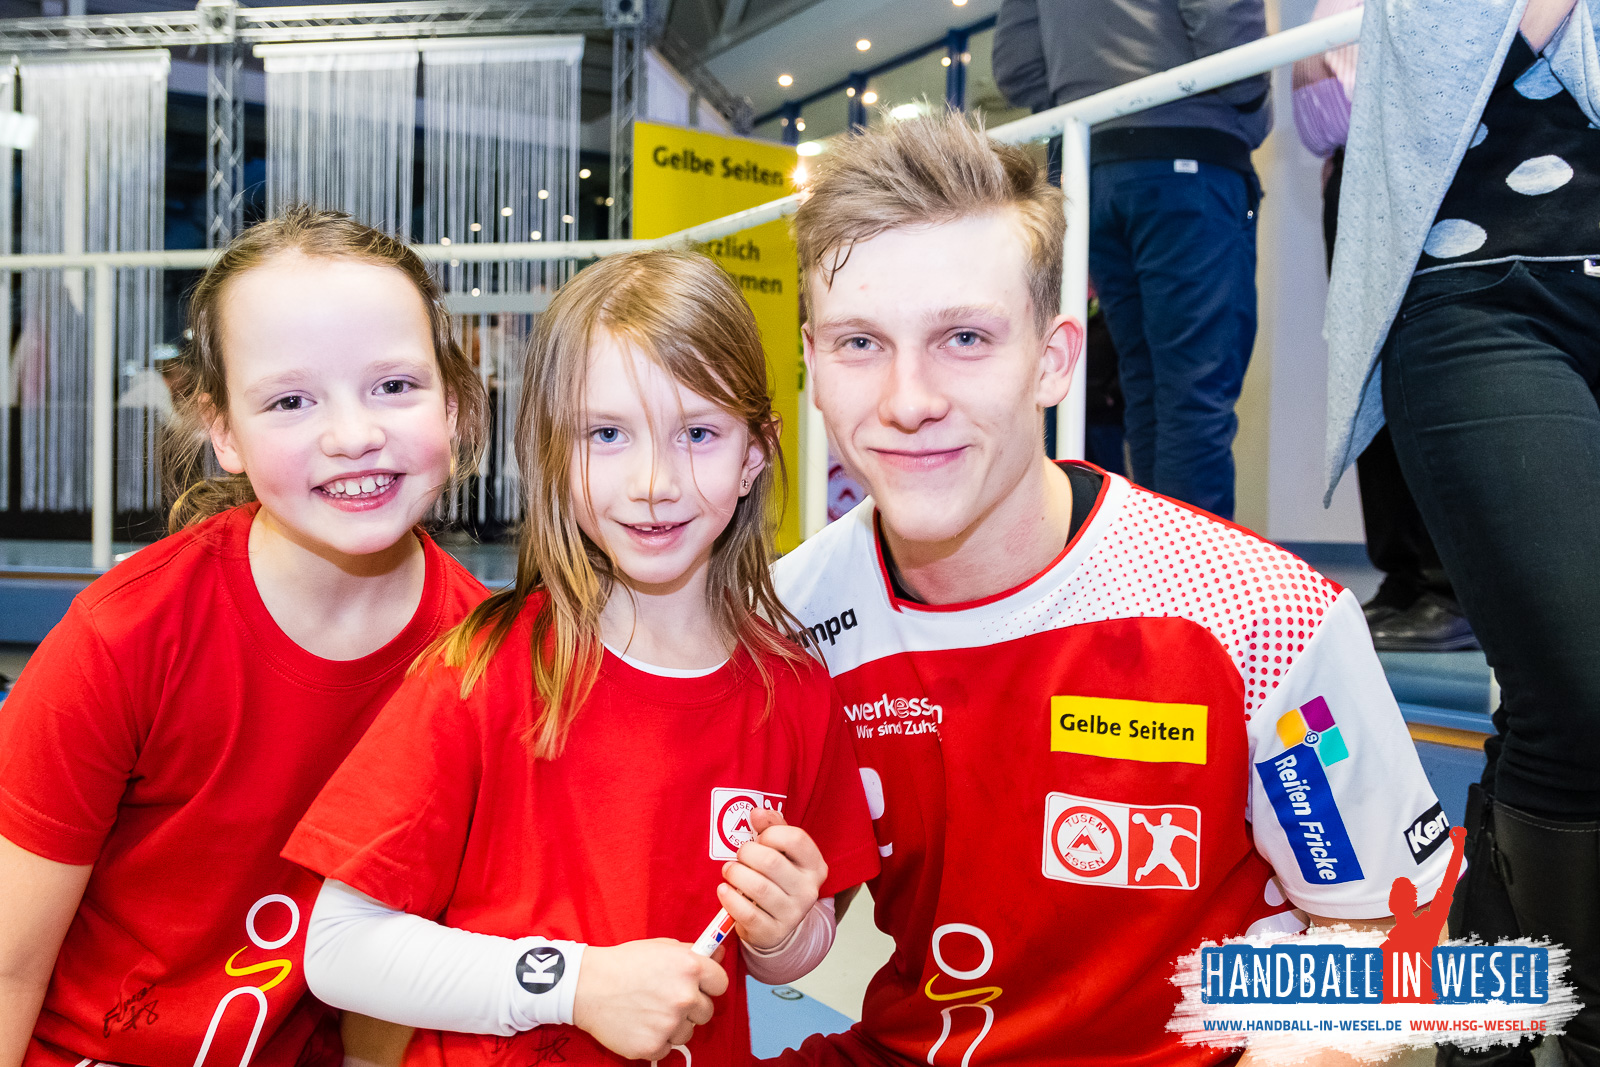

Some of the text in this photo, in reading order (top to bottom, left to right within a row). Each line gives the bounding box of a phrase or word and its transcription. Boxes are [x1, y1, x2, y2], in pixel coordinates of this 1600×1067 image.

[652, 146, 784, 186] Gelbe Seiten
[856, 719, 938, 738] Wir sind Zuha
[1060, 713, 1194, 741] Gelbe Seiten
[1065, 814, 1108, 834] TUSEM
[1275, 754, 1338, 880] Reifen Fricke
[1064, 852, 1106, 870] ESSEN
